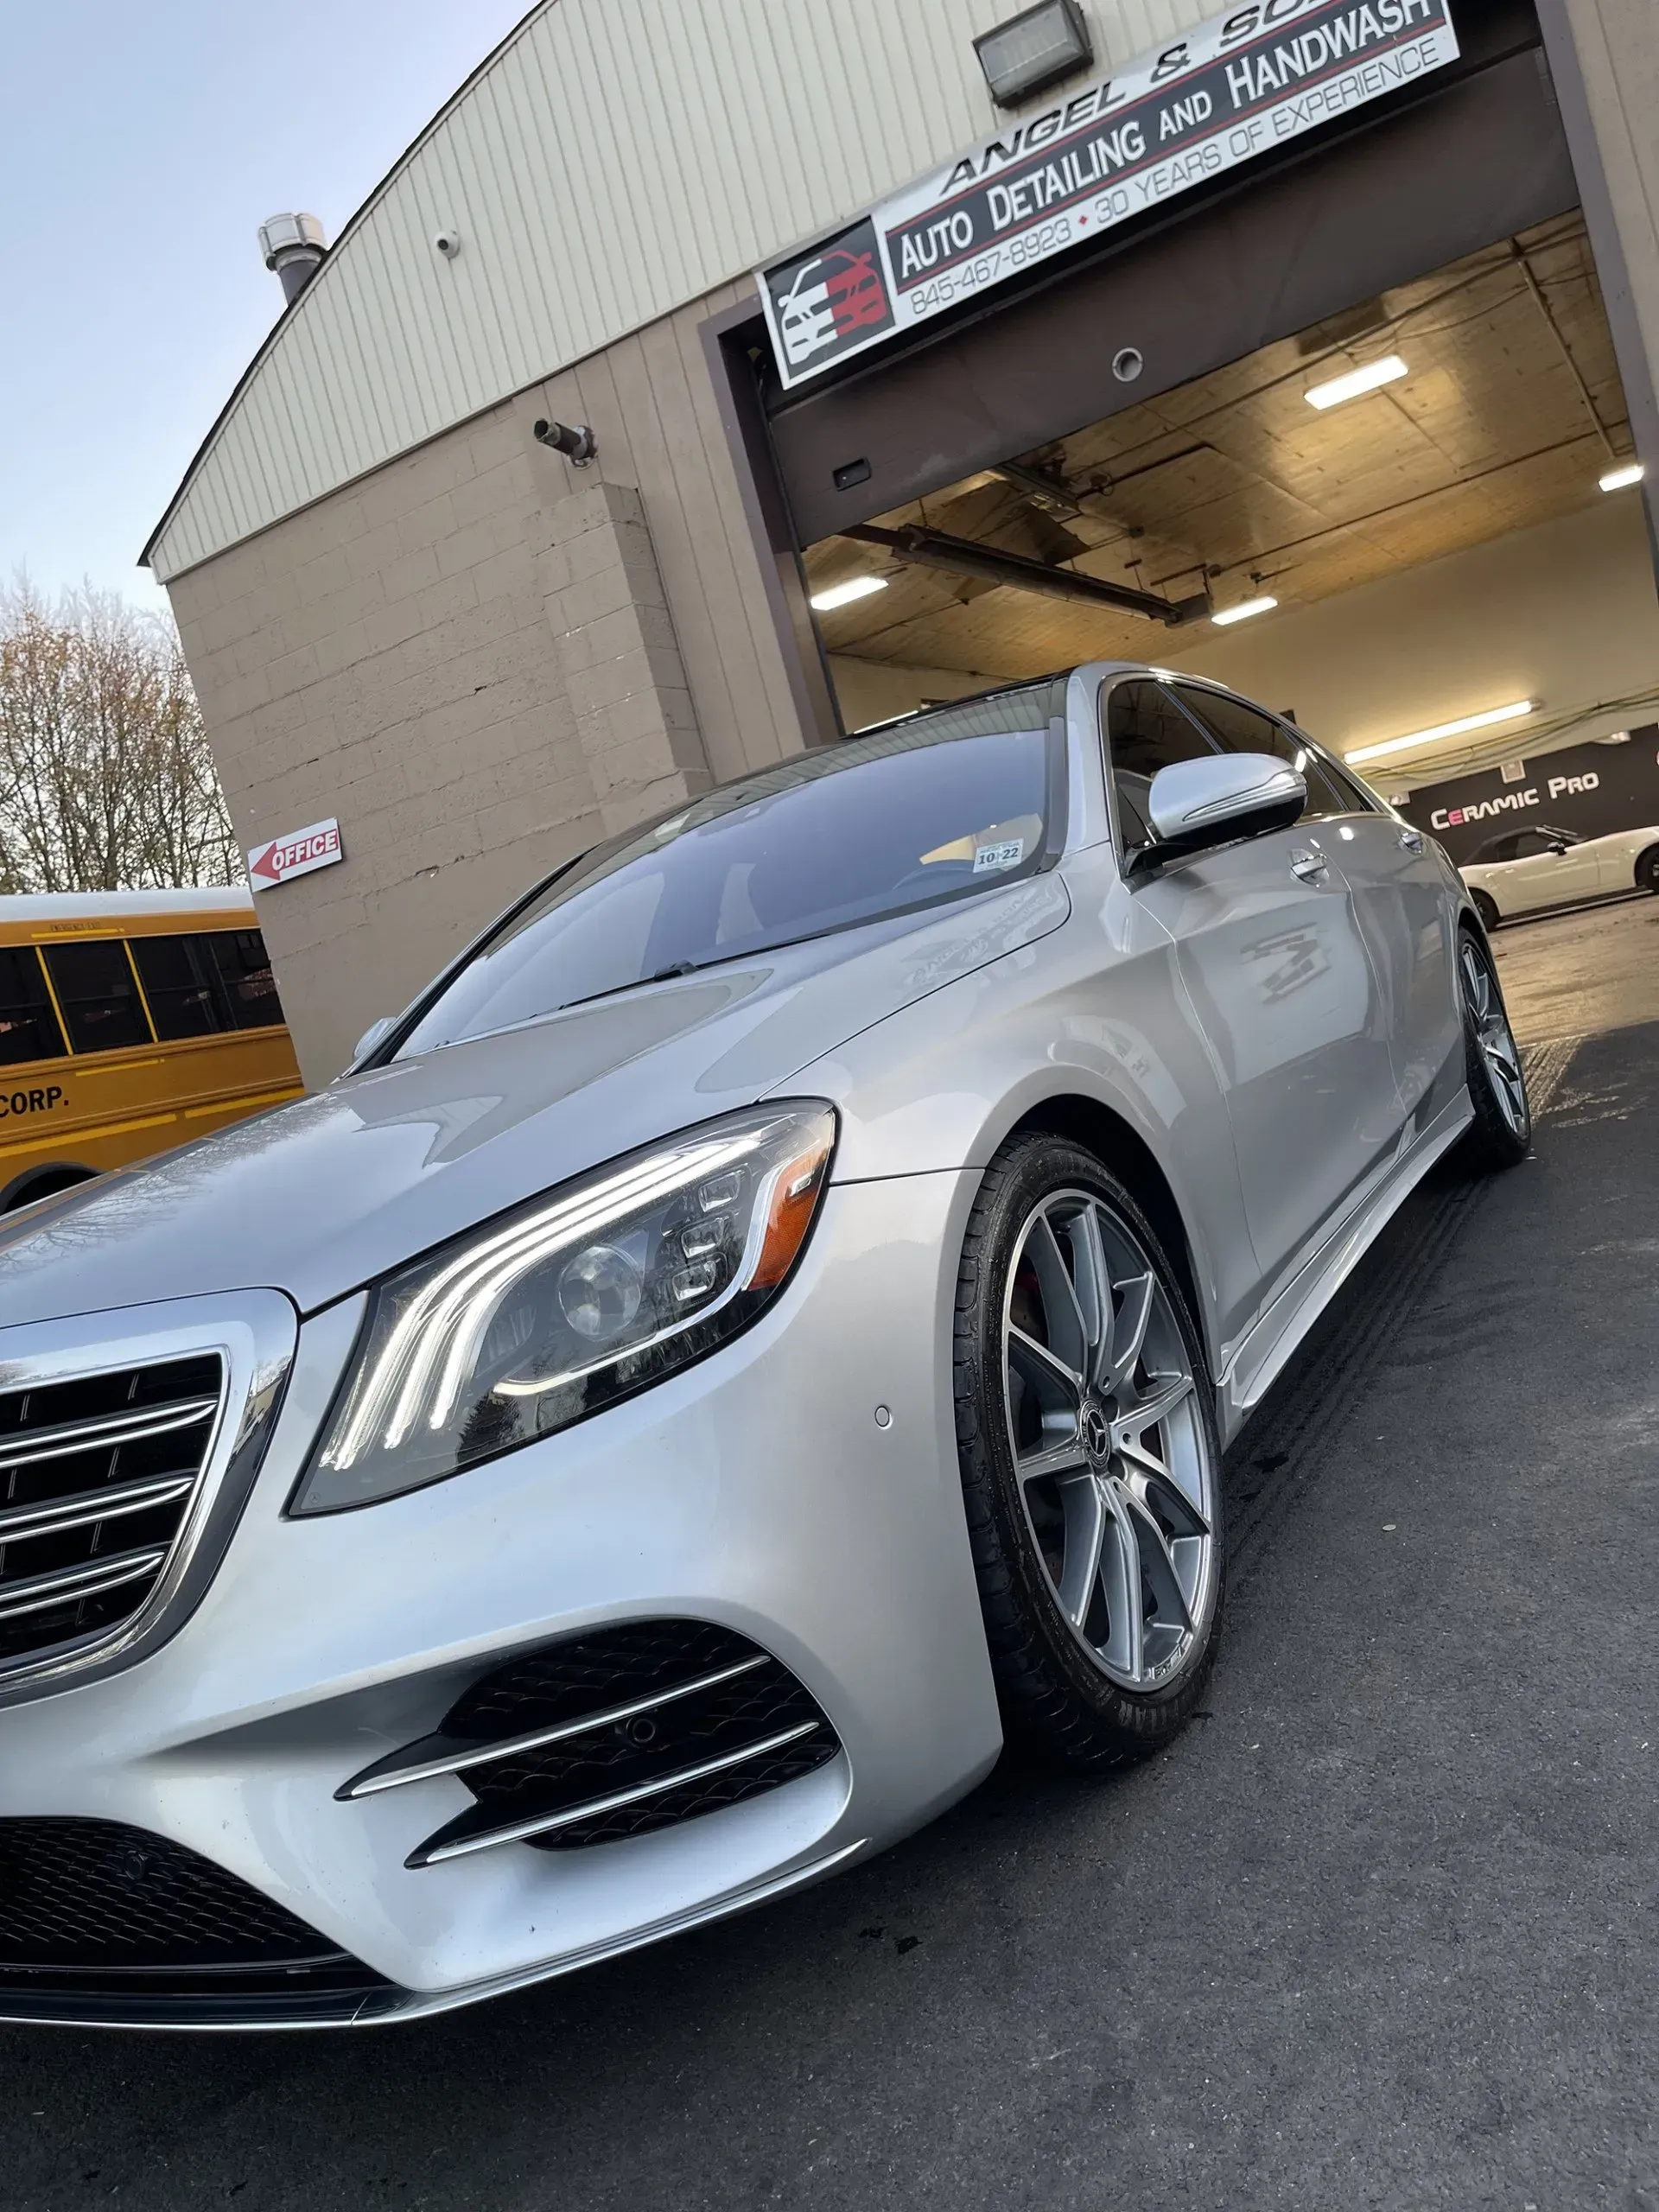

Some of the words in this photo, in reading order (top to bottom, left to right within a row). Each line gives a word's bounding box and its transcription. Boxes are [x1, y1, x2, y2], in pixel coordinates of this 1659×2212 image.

[901, 211, 974, 278] AUTO
[986, 121, 1147, 231] DETAILING
[1159, 90, 1212, 142] AND
[1224, 0, 1431, 110] HANDWASH
[939, 81, 1126, 196] ANGEL
[1149, 42, 1191, 84] &
[911, 218, 1072, 315] 845-467-8923
[1094, 191, 1129, 224] 30
[1135, 143, 1223, 203] YEARS
[1229, 121, 1264, 158] OF
[1274, 37, 1440, 137] EXPERIENCE
[1430, 788, 1541, 830] CERAMIC
[1547, 772, 1600, 798] PRO
[271, 830, 337, 871] OFFICE
[978, 852, 995, 865] 10
[1001, 847, 1019, 860] 22
[0, 1086, 69, 1118] CORP.
